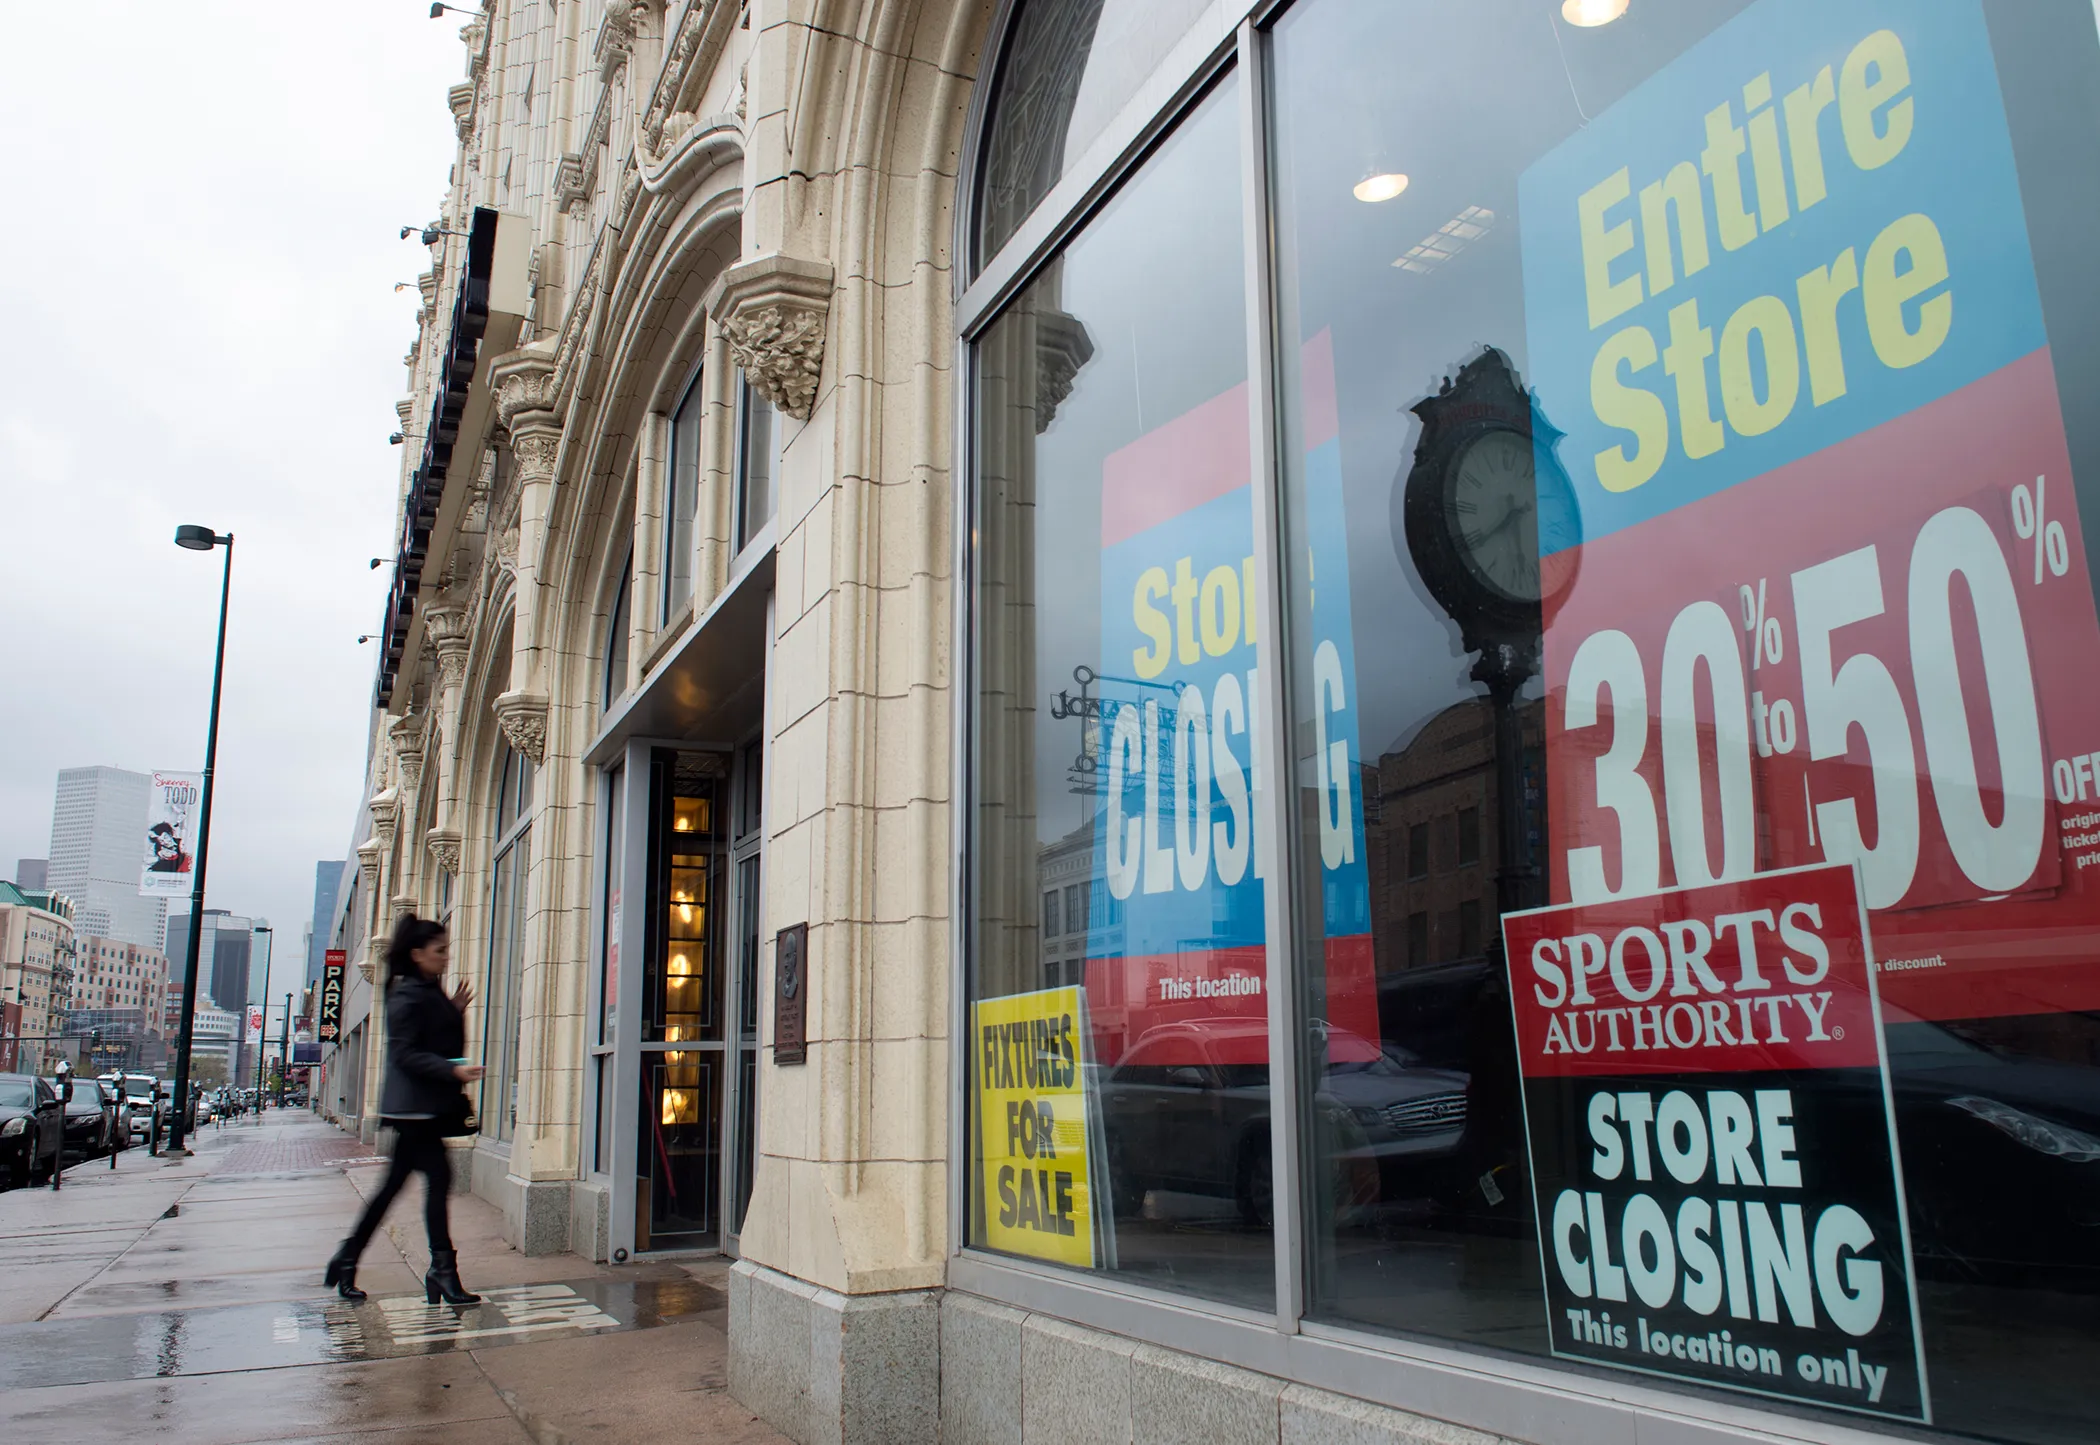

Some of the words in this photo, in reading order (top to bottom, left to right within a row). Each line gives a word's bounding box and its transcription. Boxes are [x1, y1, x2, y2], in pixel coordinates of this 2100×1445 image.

[1578, 29, 1914, 331] Entire
[1590, 213, 1952, 493] Store
[1752, 690, 1797, 757] to
[164, 786, 197, 805] TODD
[1105, 639, 1355, 900] CLOSIG
[324, 966, 340, 1019] PARK
[1159, 976, 1192, 999] This
[1196, 972, 1261, 998] location
[1531, 902, 1830, 1009] SPORTS
[1884, 954, 1947, 972] discount.
[982, 1013, 1076, 1091] FIXTURES
[1008, 1100, 1057, 1159] FOR
[1587, 1089, 1803, 1188] STORE
[997, 1165, 1076, 1237] SALE
[1553, 1189, 1885, 1337] CLOSING
[1567, 1310, 1629, 1349] This
[1640, 1319, 1783, 1377] location
[1798, 1350, 1888, 1402] only
